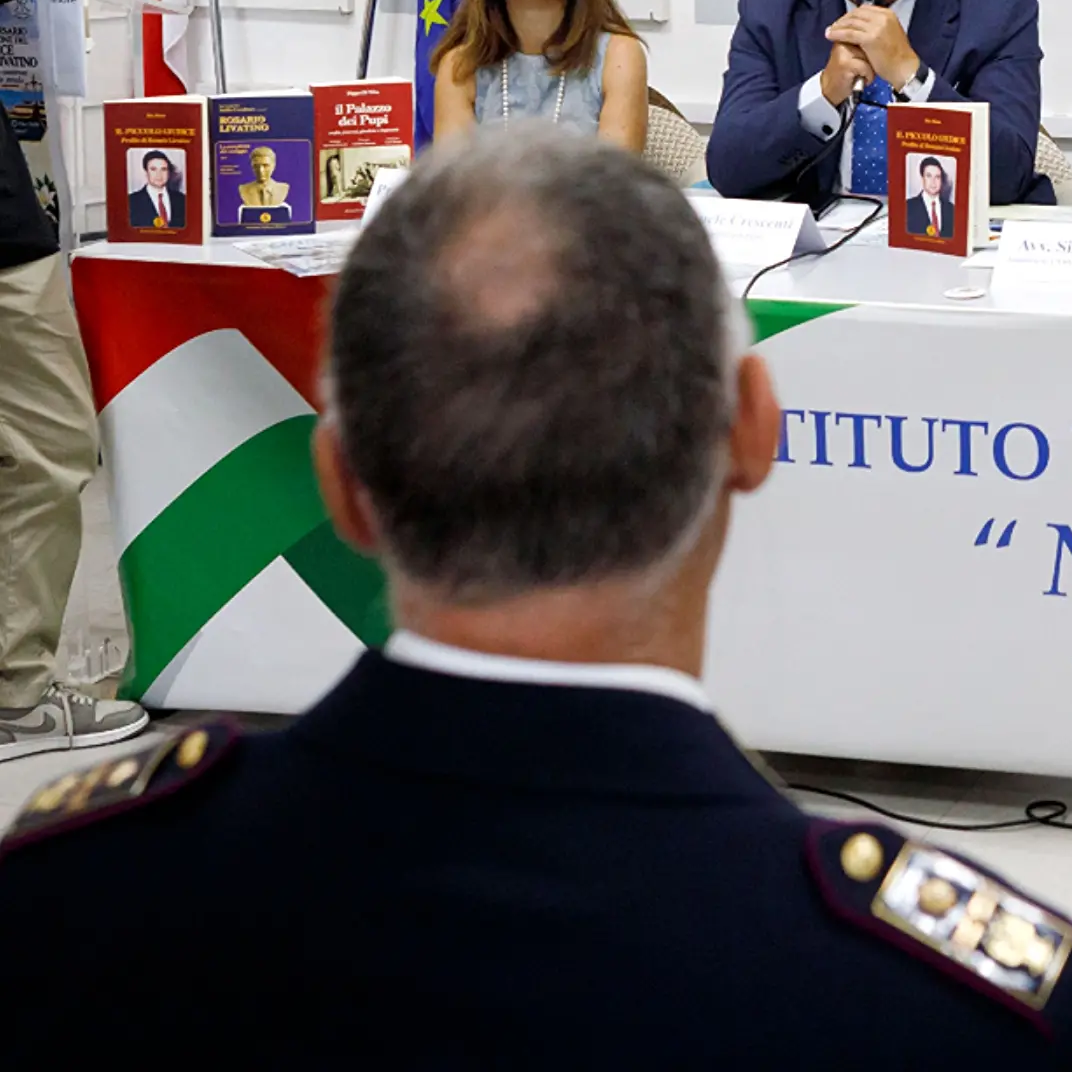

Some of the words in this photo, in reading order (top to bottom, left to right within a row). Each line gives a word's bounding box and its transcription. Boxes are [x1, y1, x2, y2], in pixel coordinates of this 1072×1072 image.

[346, 102, 392, 115] Palazzo
[219, 115, 267, 124] ROSARIO
[338, 115, 357, 127] dei
[360, 114, 389, 128] Pupi
[219, 124, 270, 133] LIVATINO
[1018, 239, 1051, 253] Avv.
